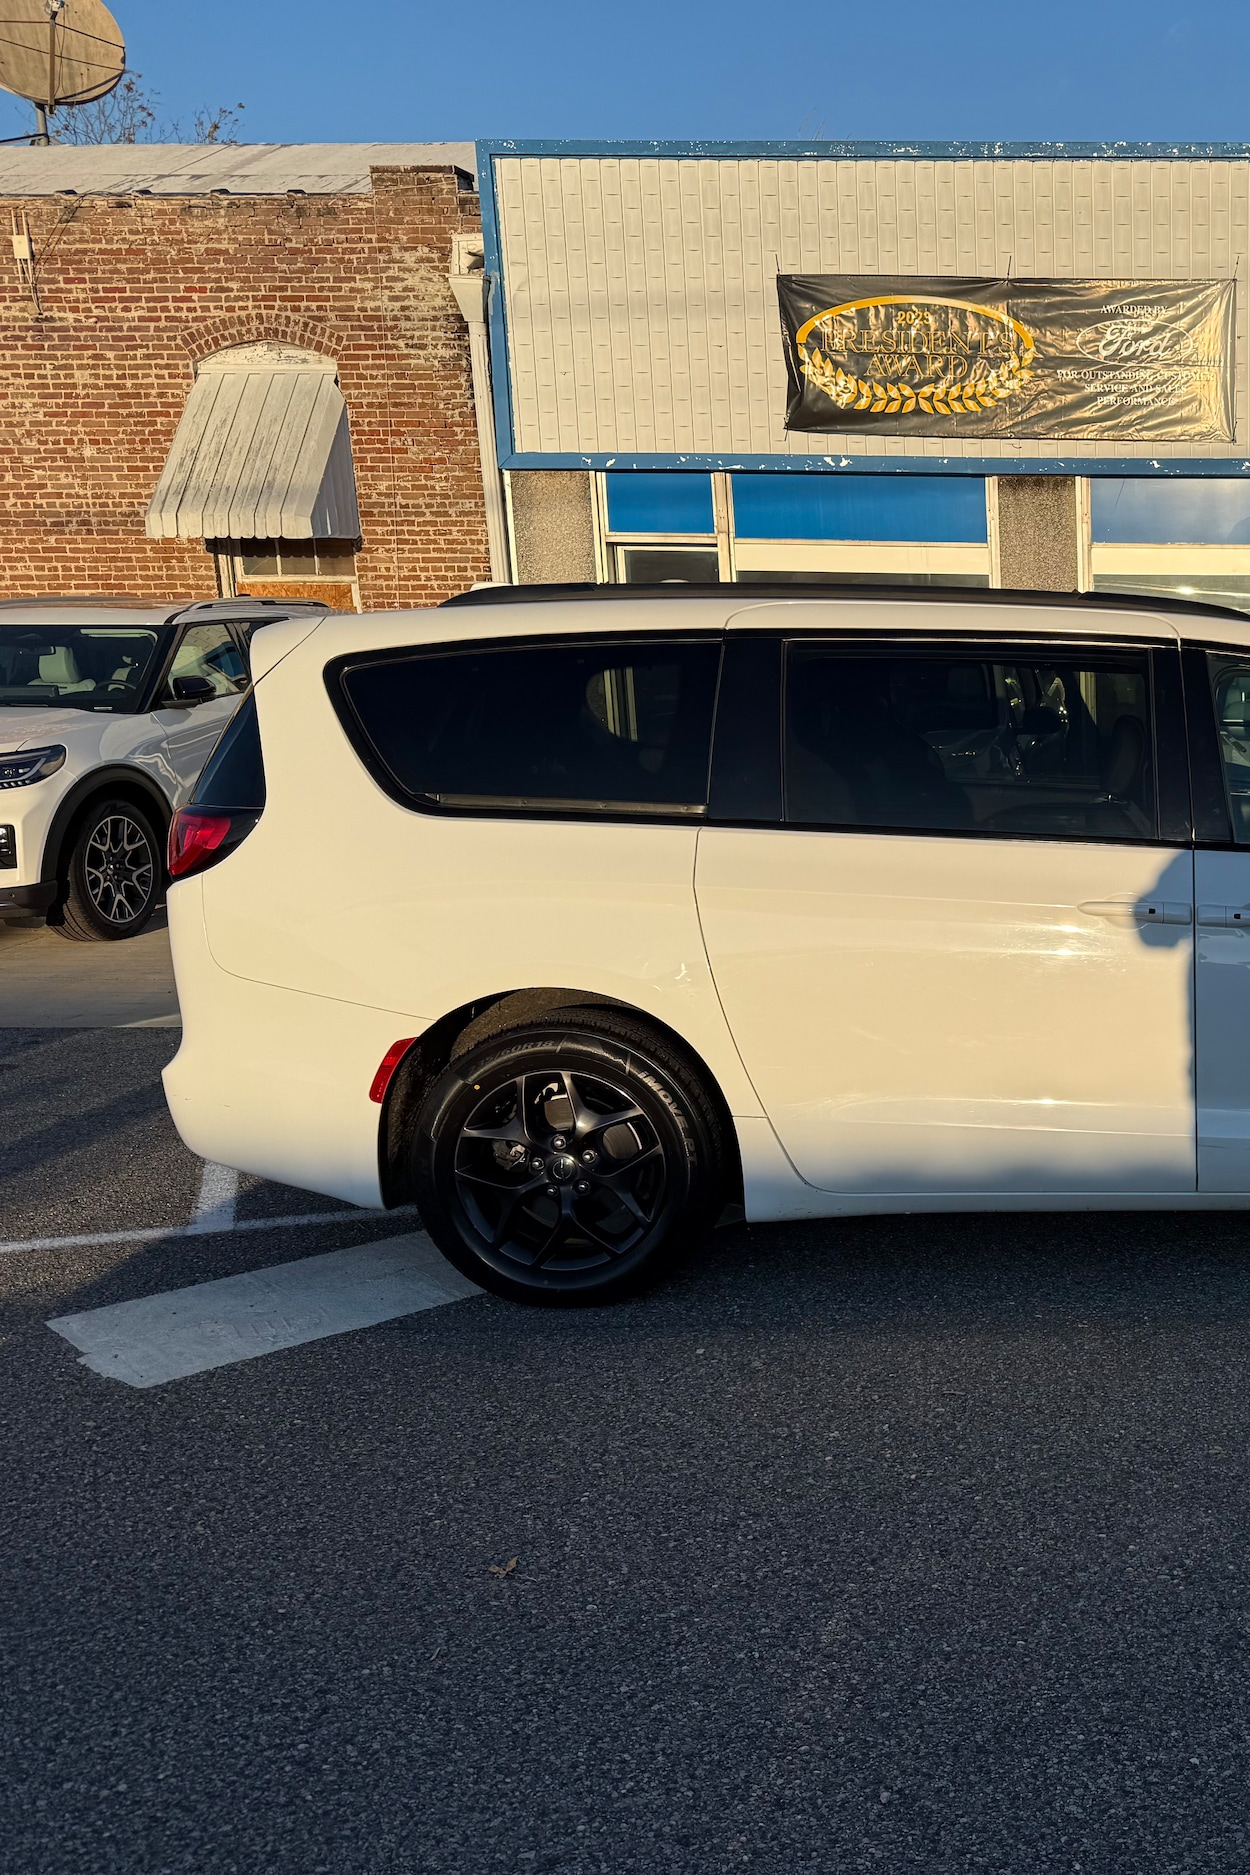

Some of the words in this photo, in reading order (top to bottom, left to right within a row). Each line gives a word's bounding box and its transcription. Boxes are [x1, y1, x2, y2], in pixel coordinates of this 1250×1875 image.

[1100, 305, 1151, 314] AWARDED
[1153, 306, 1168, 314] BY
[897, 311, 931, 325] 2023
[820, 328, 1014, 354] PRESIDENT'S
[1098, 324, 1173, 359] Ford
[863, 354, 968, 378] AWARD
[1057, 370, 1077, 380] FOR
[1081, 370, 1154, 380] OUTSTANDING
[1157, 371, 1214, 381] CUSTOMER
[1084, 384, 1129, 393] SERVICE
[1132, 384, 1151, 393] AND
[1155, 384, 1187, 393] SALES
[1097, 396, 1174, 405] PERFORMANCE
